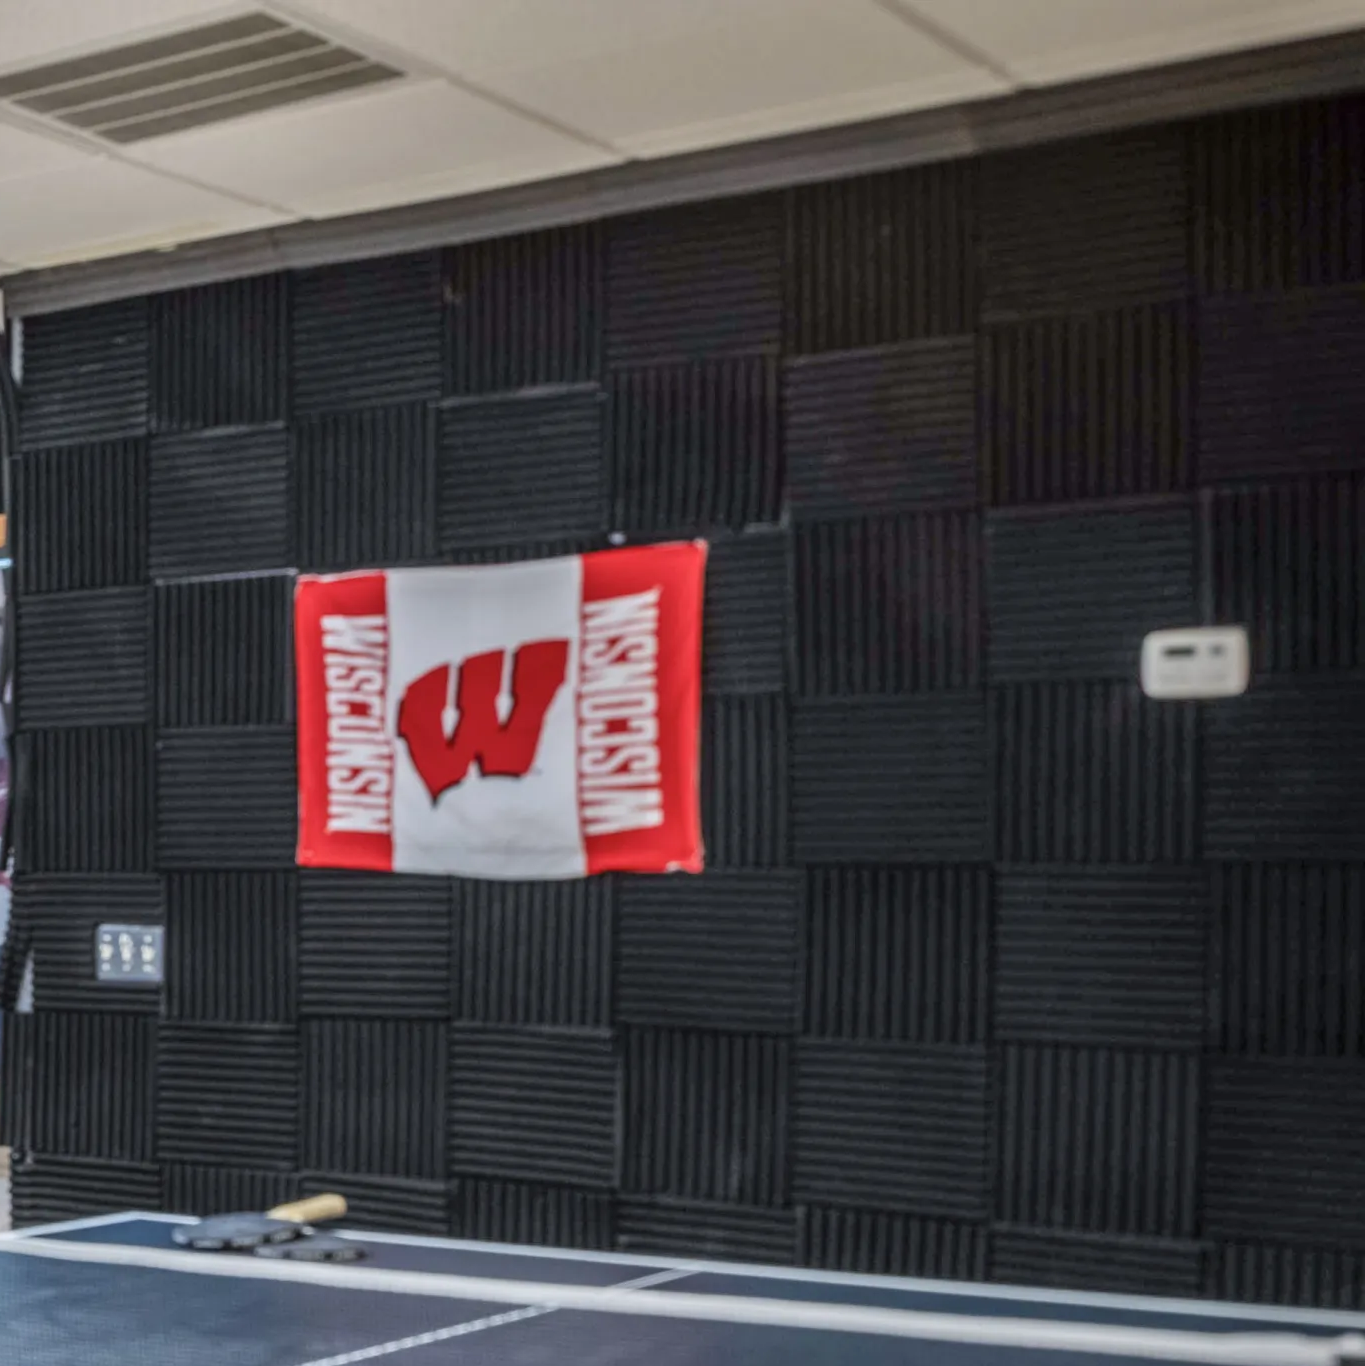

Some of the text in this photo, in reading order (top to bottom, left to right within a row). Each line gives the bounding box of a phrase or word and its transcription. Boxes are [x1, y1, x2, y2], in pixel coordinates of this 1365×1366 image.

[320, 613, 392, 835] WISCONSIN
[397, 639, 570, 809] W
[579, 585, 664, 836] WISCONSIN
